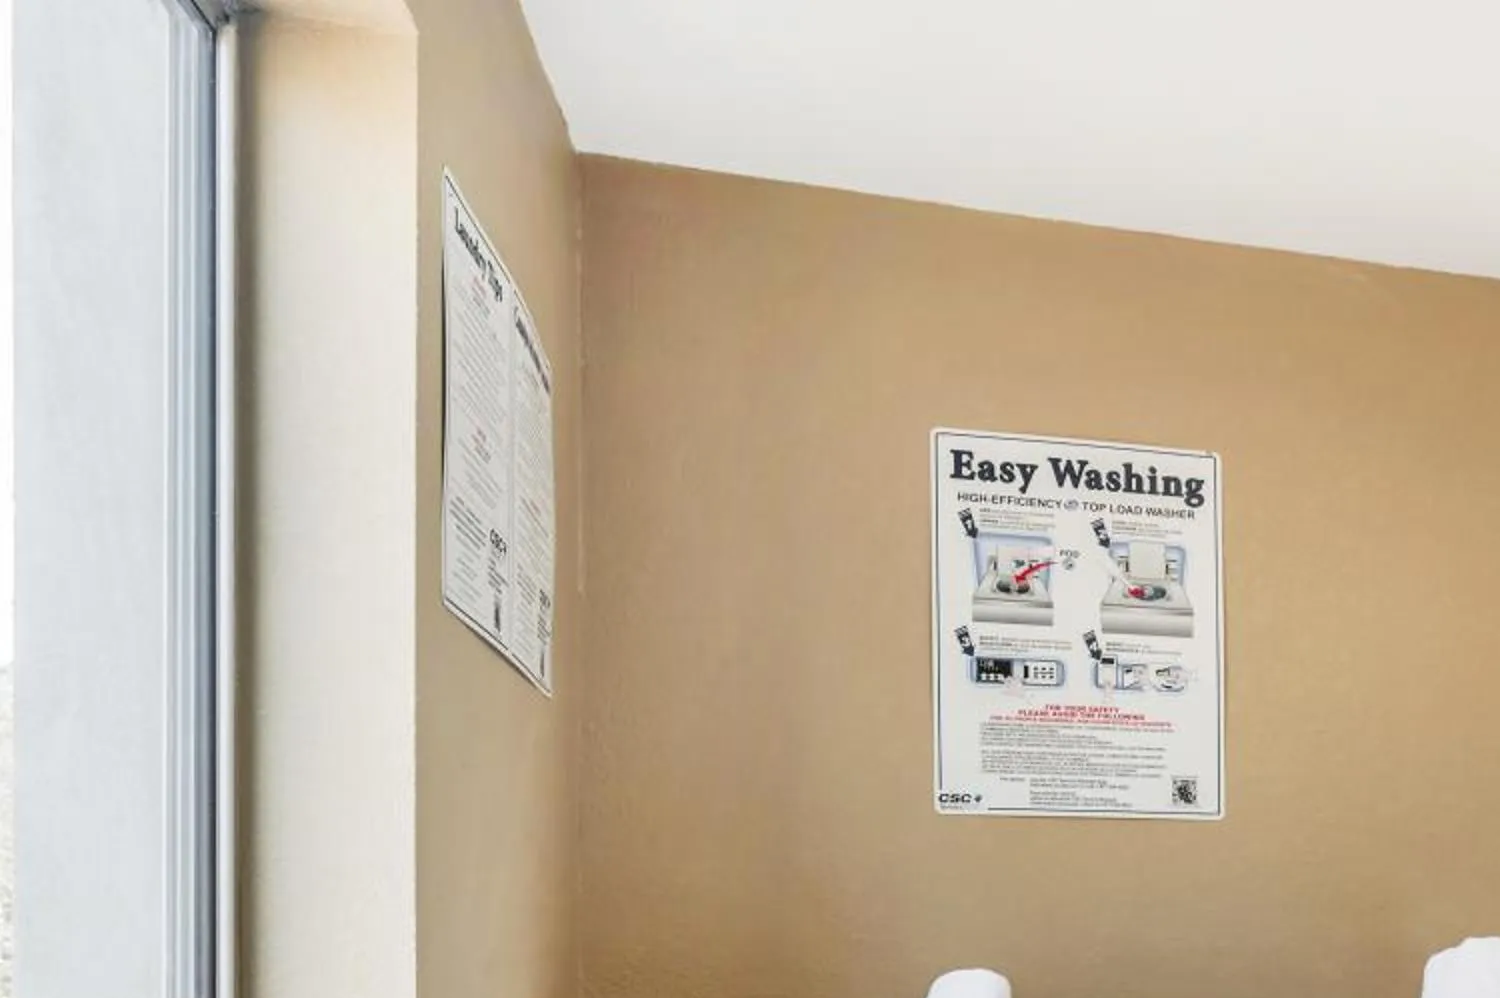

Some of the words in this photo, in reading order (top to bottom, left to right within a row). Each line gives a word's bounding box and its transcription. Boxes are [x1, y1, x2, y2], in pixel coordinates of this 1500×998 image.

[949, 449, 1038, 494] Easy
[1048, 457, 1205, 507] Washing
[1082, 502, 1106, 512] TOP
[1109, 504, 1142, 514] LOAD
[1145, 507, 1195, 519] WASHER
[938, 793, 972, 803] CSC
